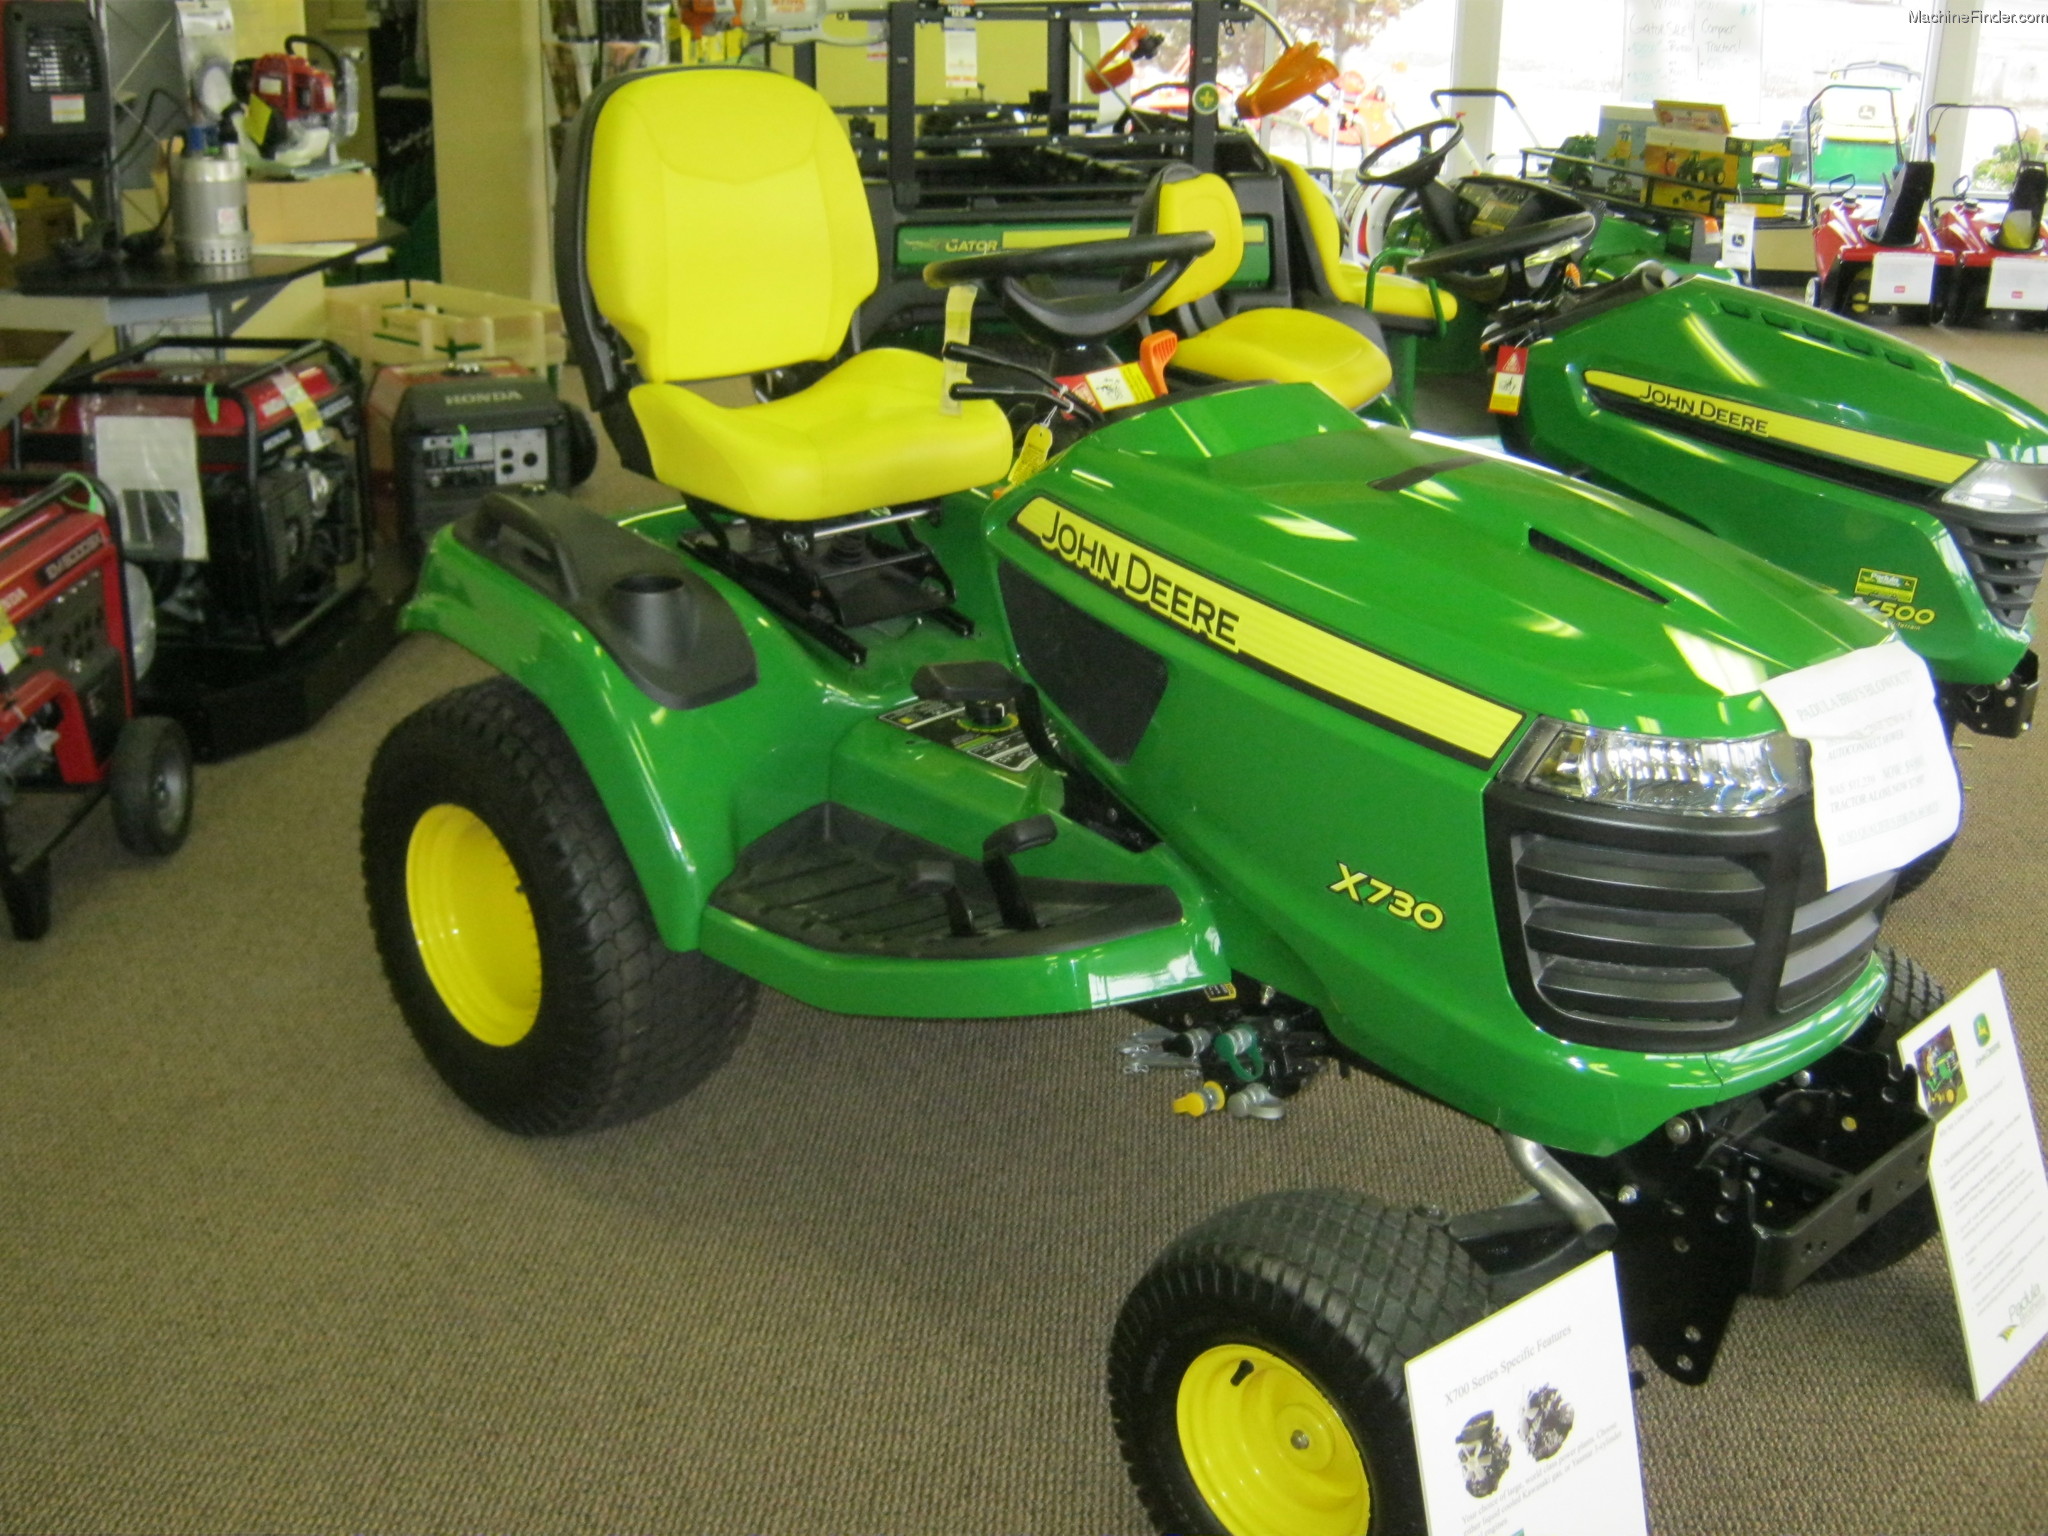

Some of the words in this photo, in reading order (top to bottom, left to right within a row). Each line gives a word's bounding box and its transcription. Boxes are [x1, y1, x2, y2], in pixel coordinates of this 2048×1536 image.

[945, 238, 998, 253] GATOR
[1641, 384, 1695, 413] JOHN
[1699, 400, 1769, 436] DEERE
[1041, 510, 1120, 582] JOHN
[1125, 552, 1240, 647] DEERE
[1797, 695, 1839, 722] PADULA
[1829, 792, 1868, 814] TRACTOR
[1328, 861, 1445, 931] X730
[1444, 1382, 1471, 1407] X700
[1470, 1366, 1499, 1390] Series
[1499, 1344, 1535, 1376] Specific
[1536, 1324, 1572, 1353] Features
